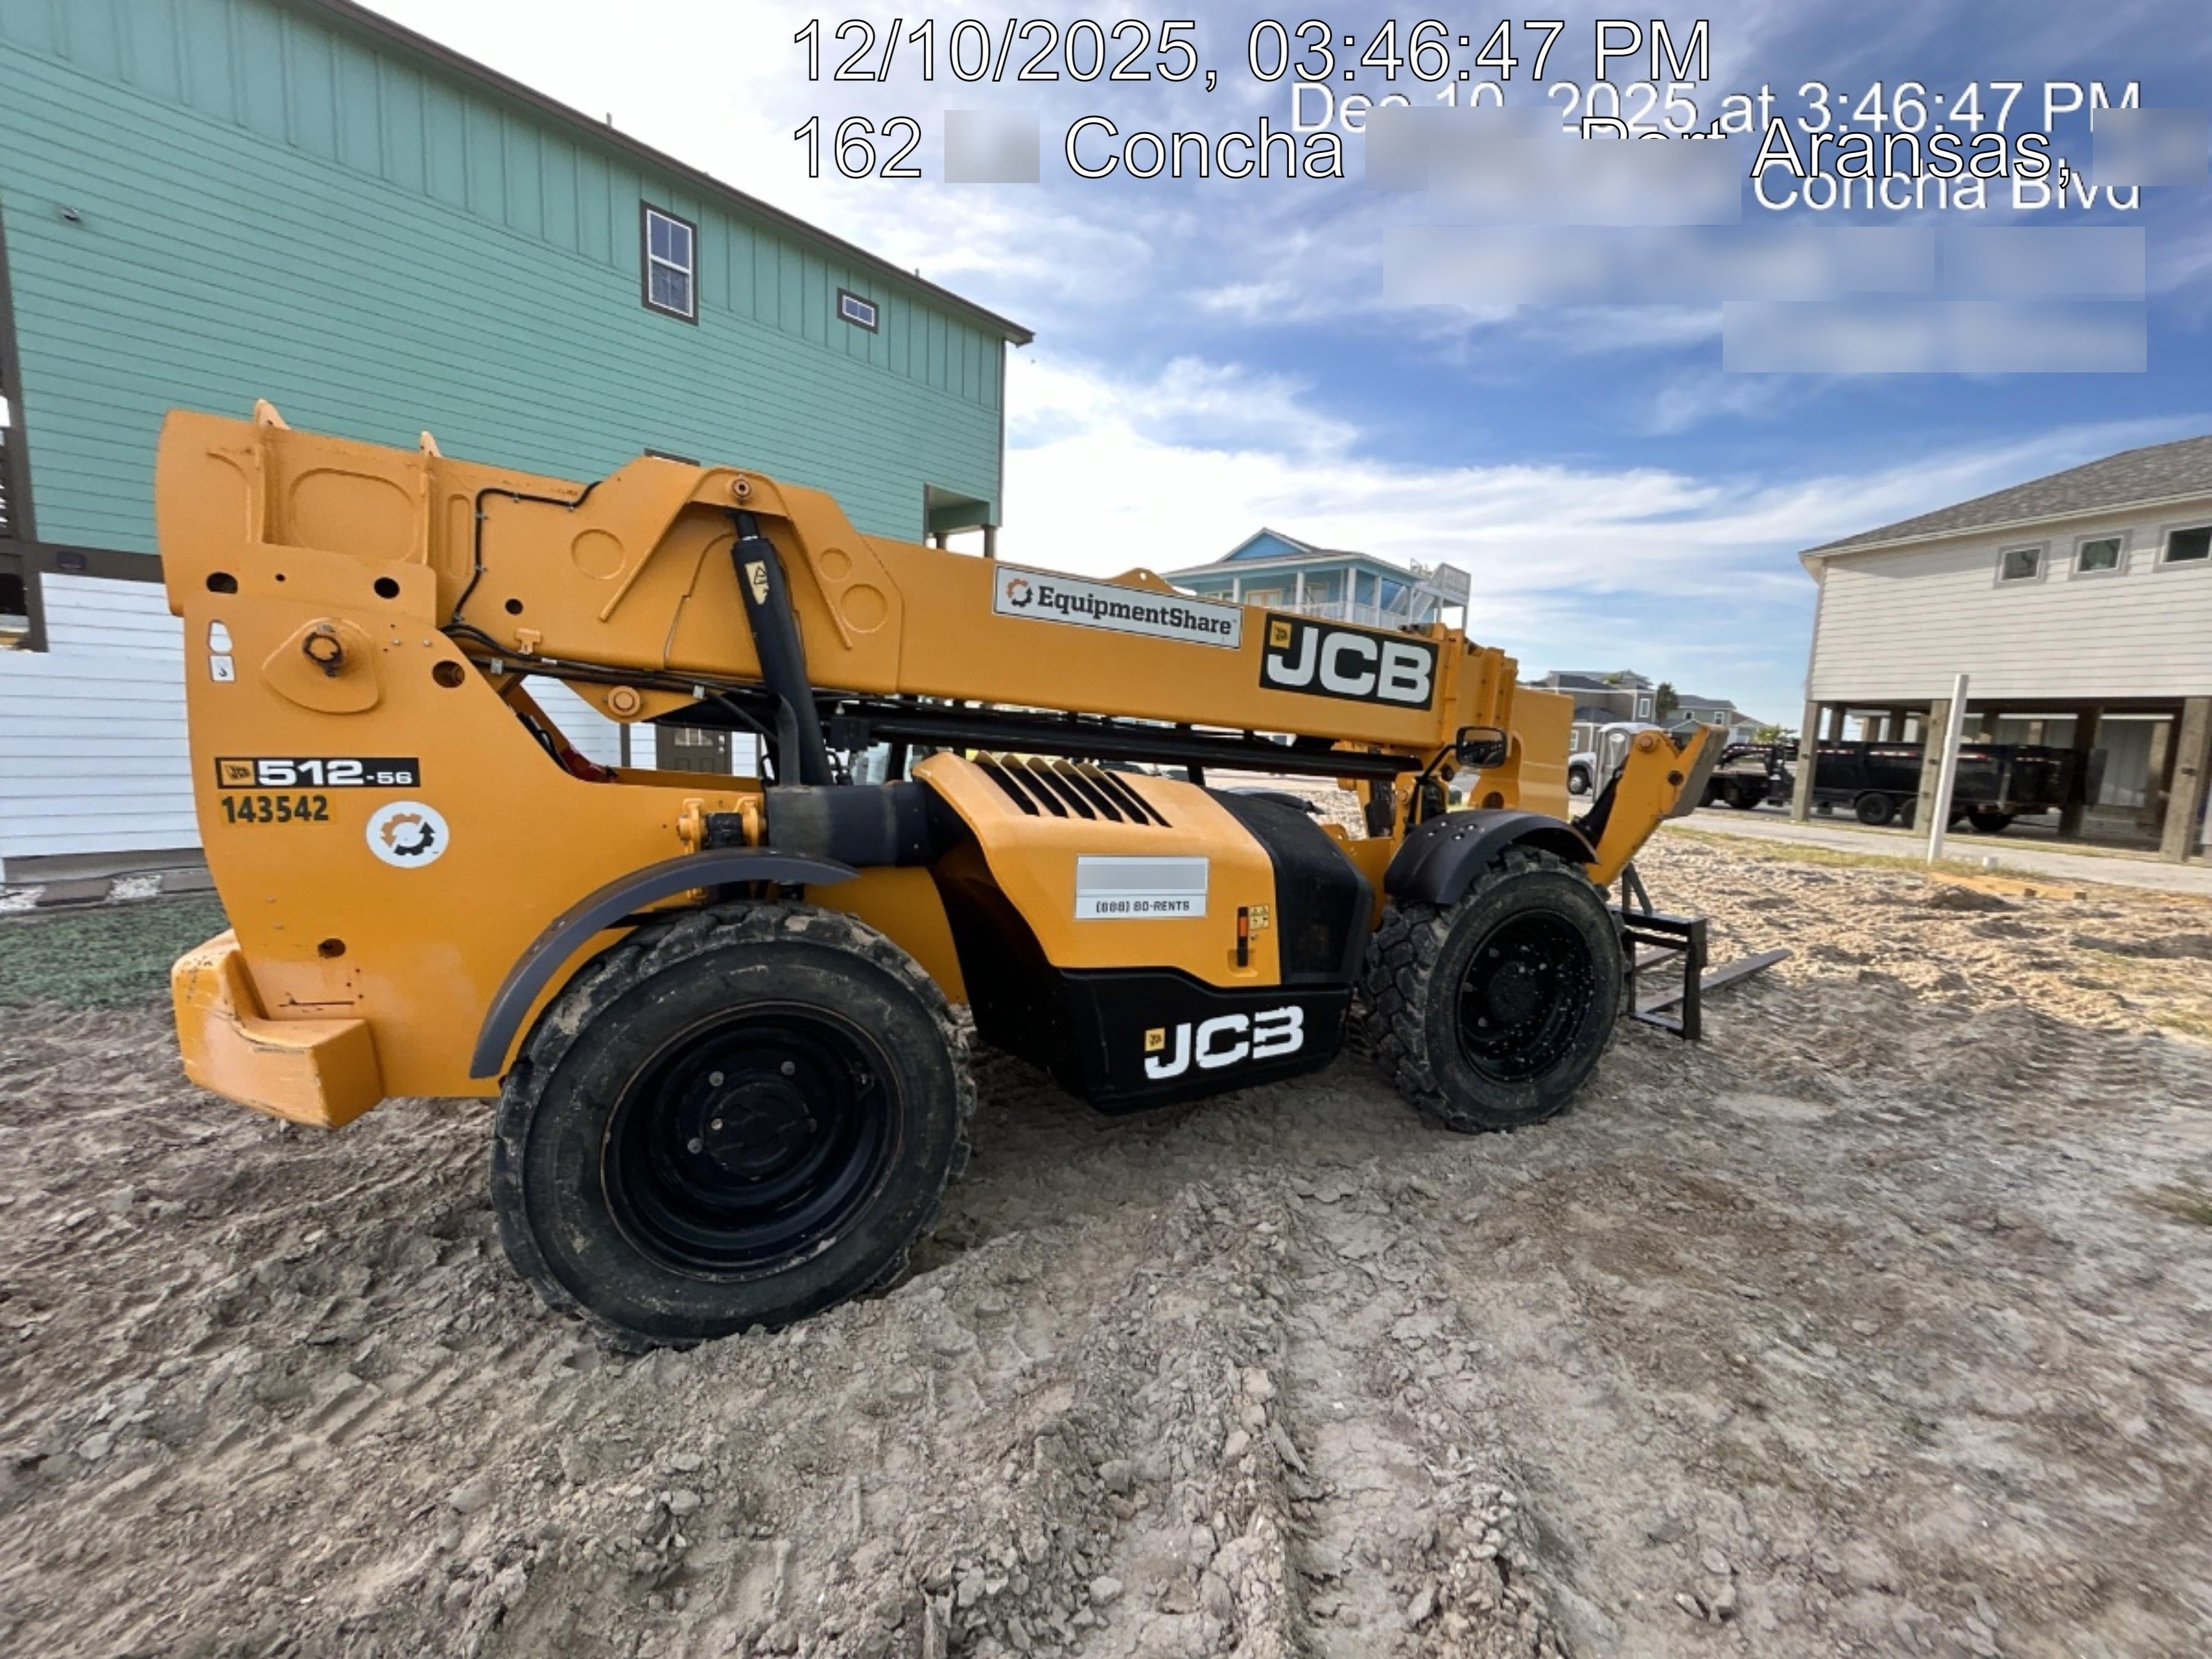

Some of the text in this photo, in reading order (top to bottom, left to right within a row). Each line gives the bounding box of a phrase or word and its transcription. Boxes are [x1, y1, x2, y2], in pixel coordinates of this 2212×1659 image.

[1037, 583, 1233, 636] EquipmentShare
[1267, 626, 1433, 704] JCB
[257, 759, 413, 786] 512-56
[221, 794, 329, 825] 143542
[1145, 1005, 1304, 1080] JCB
